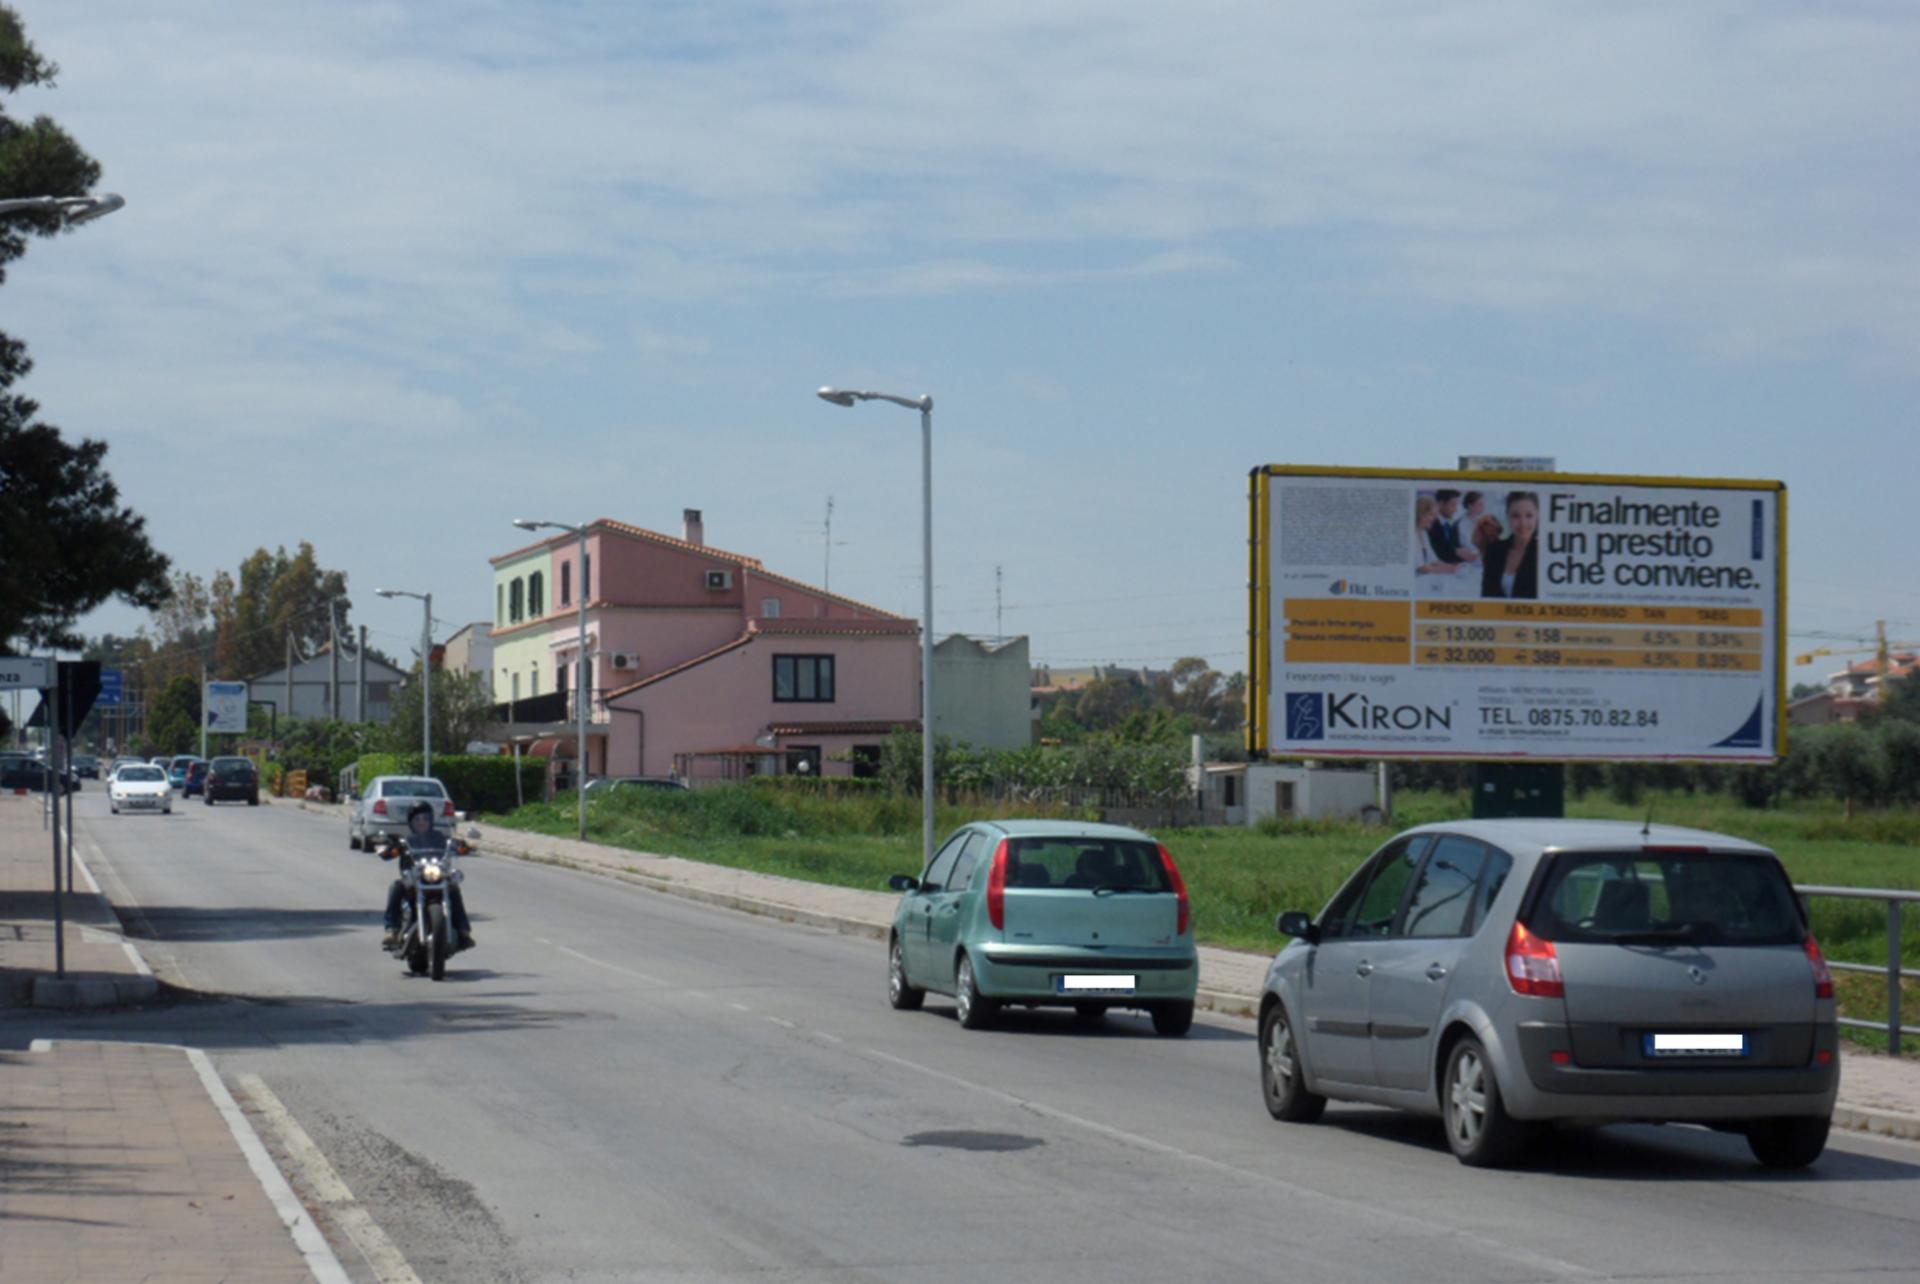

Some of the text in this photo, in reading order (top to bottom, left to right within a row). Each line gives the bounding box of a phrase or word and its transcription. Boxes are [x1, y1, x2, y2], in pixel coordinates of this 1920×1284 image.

[1549, 493, 1720, 528] Finalmente
[1548, 527, 1713, 563] un prestito
[1547, 555, 1761, 590] che conviene.
[1429, 603, 1474, 614] PRENDI
[1505, 604, 1628, 618] RATA A TASSO FISSO
[1643, 608, 1666, 619] TAN
[1445, 626, 1496, 641] 13.000
[1534, 628, 1562, 643] 158
[1444, 647, 1496, 663] 32.000
[1479, 707, 1659, 727] TEL. 0875.70.82.84
